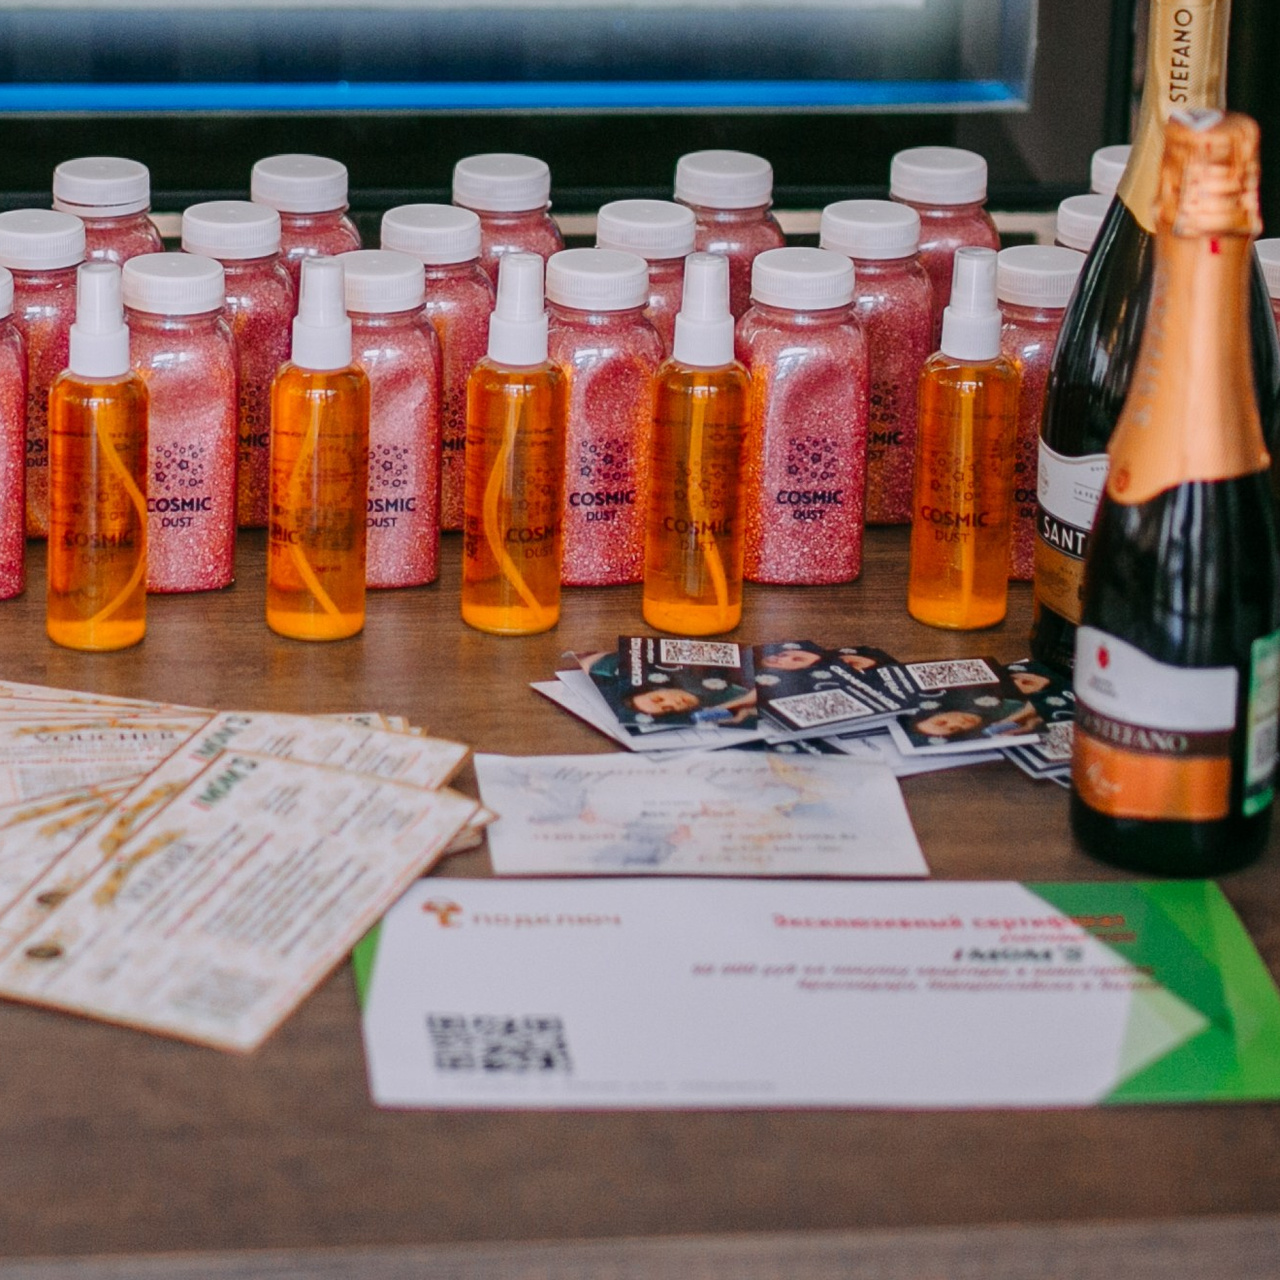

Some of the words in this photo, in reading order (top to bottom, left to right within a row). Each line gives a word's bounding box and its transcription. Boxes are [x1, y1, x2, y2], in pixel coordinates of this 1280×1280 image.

[1169, 8, 1193, 104] STEFANO
[569, 490, 636, 508] COSMIC
[776, 489, 844, 506] COSMIC
[161, 517, 195, 528] DUST
[586, 510, 618, 522] DUST
[793, 509, 826, 521] DUST
[920, 505, 991, 528] COSMIC
[663, 516, 734, 536] COSMIC
[64, 530, 134, 549] COSMIC
[934, 530, 971, 544] DUST
